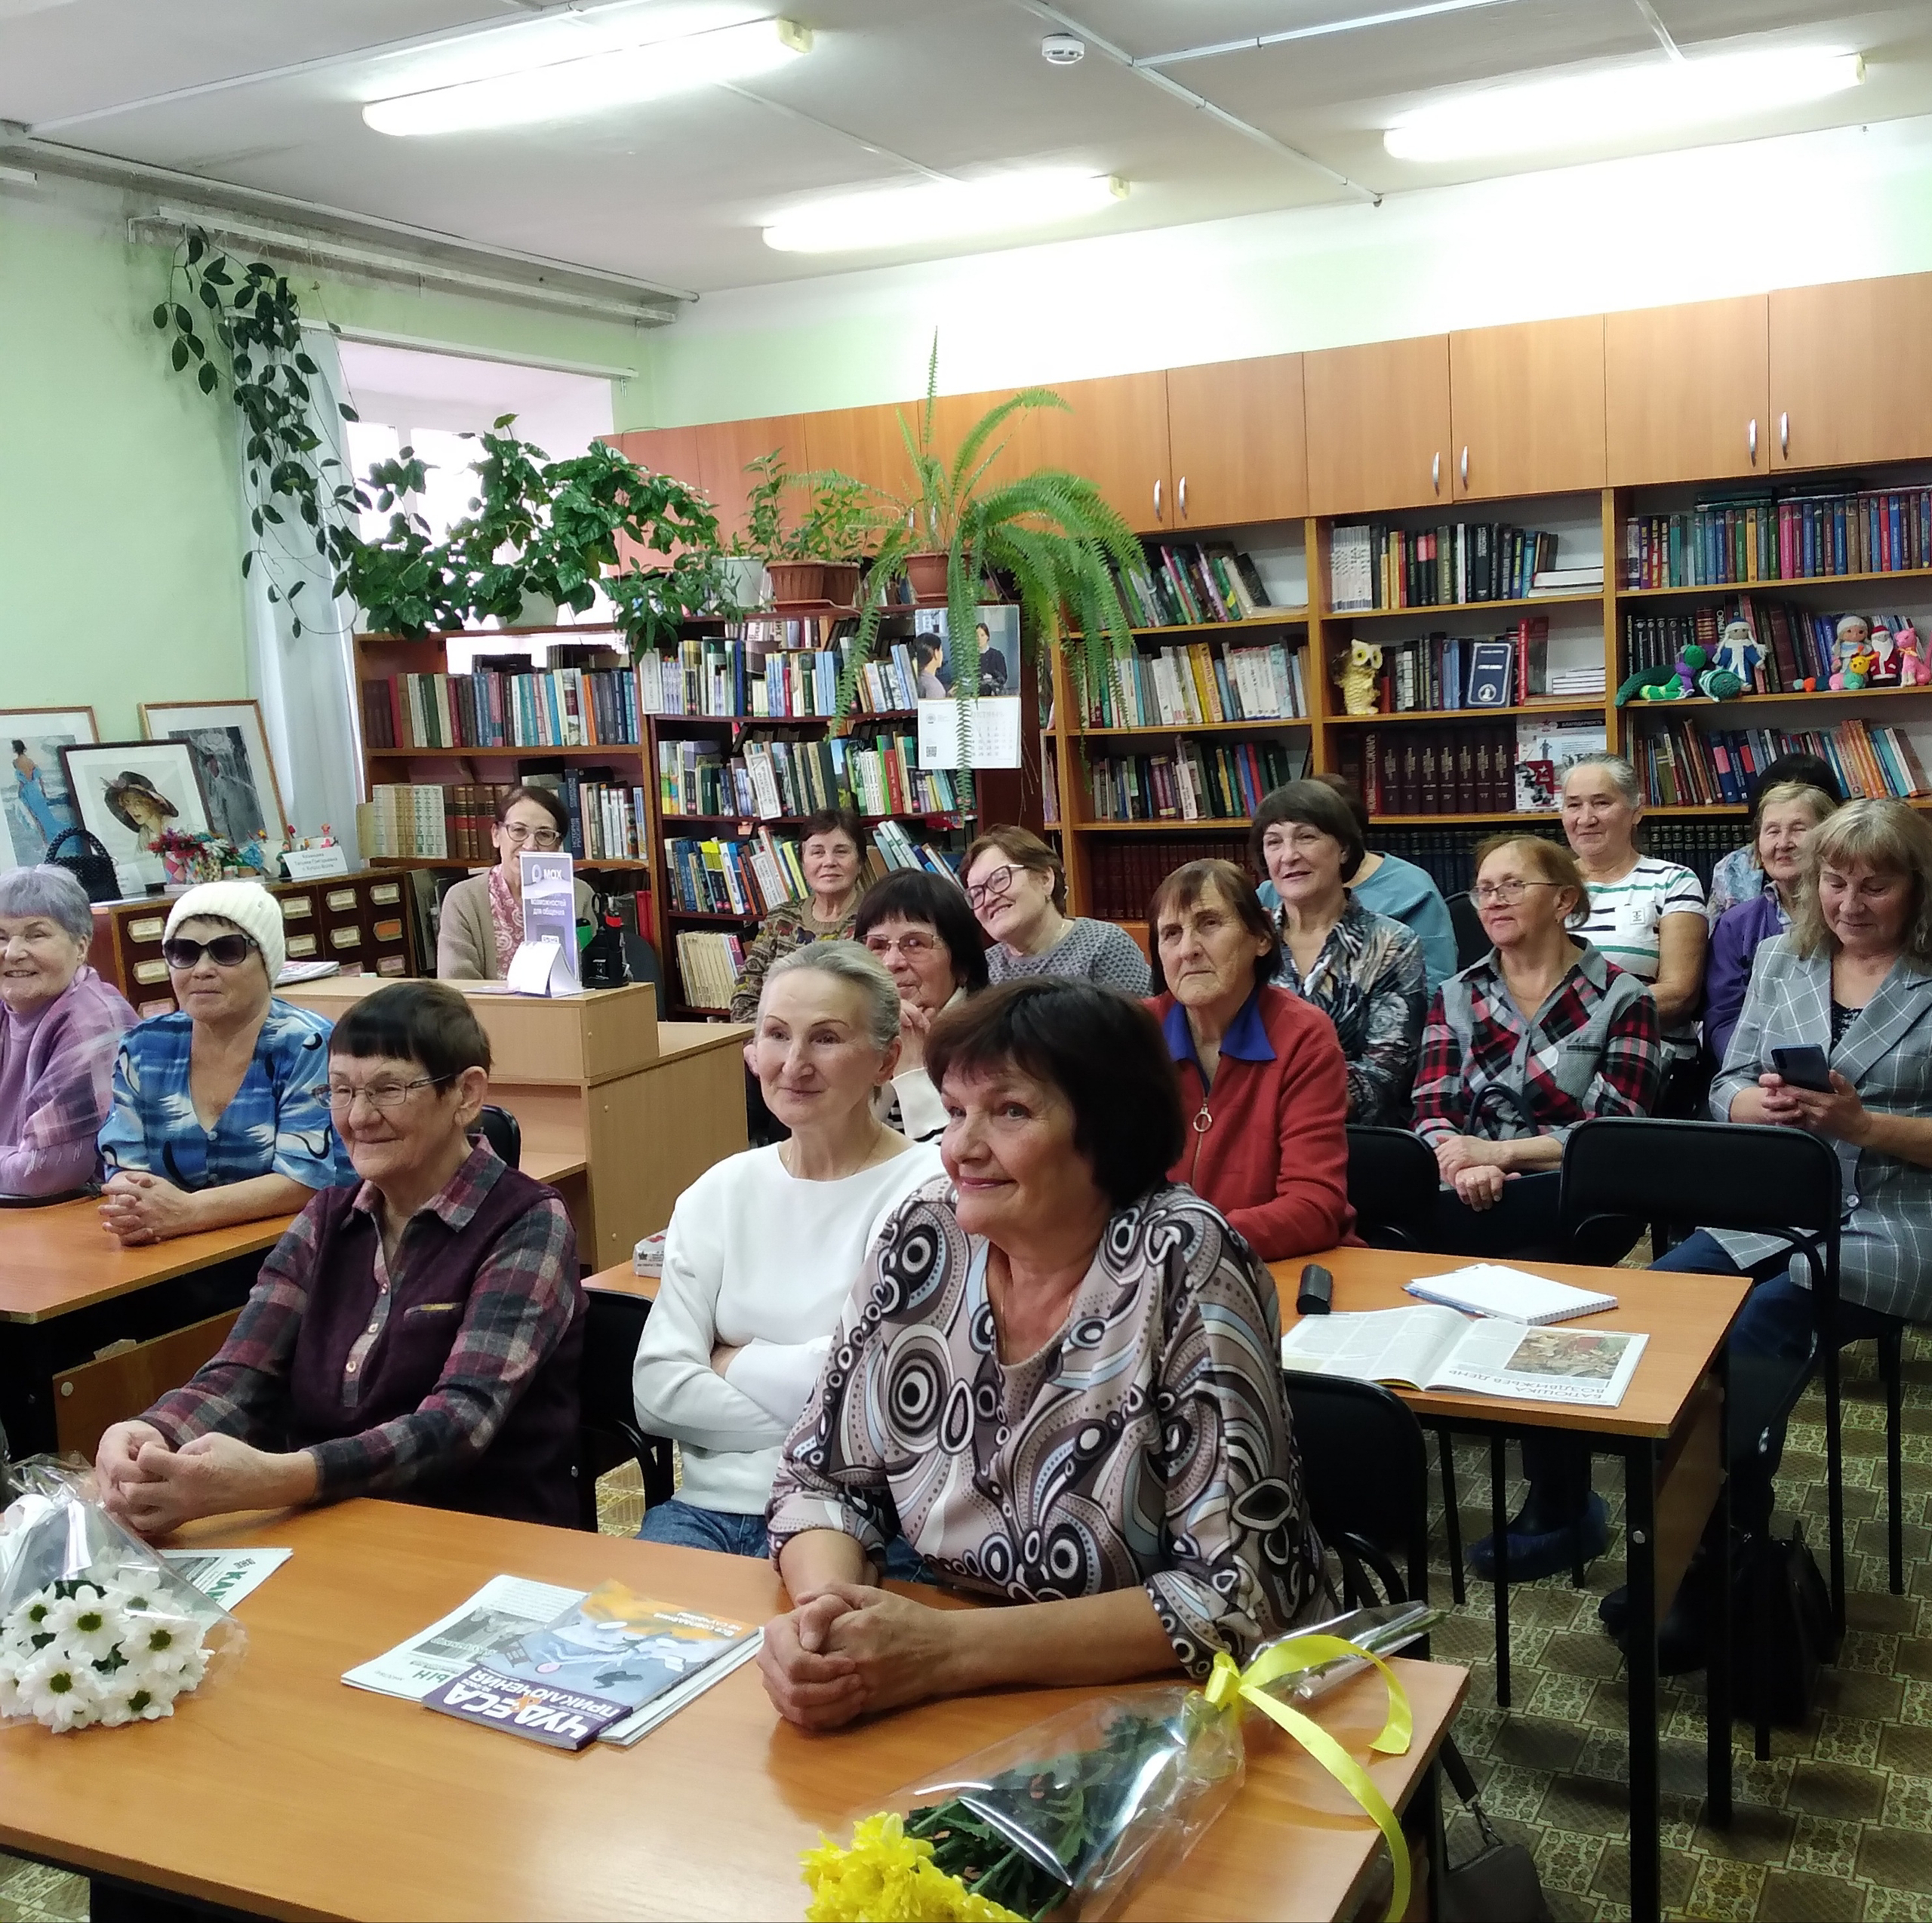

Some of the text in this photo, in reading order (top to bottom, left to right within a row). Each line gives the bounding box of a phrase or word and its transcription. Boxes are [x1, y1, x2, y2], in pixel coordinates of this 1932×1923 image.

[1448, 1369, 1491, 1380] ДЕНЬ
[1515, 1387, 1602, 1399] БАТЮШКА
[468, 1669, 620, 1718] ПРИКЛЮЧЕНИЯ
[443, 1683, 589, 1739] ЧУДЕСА
